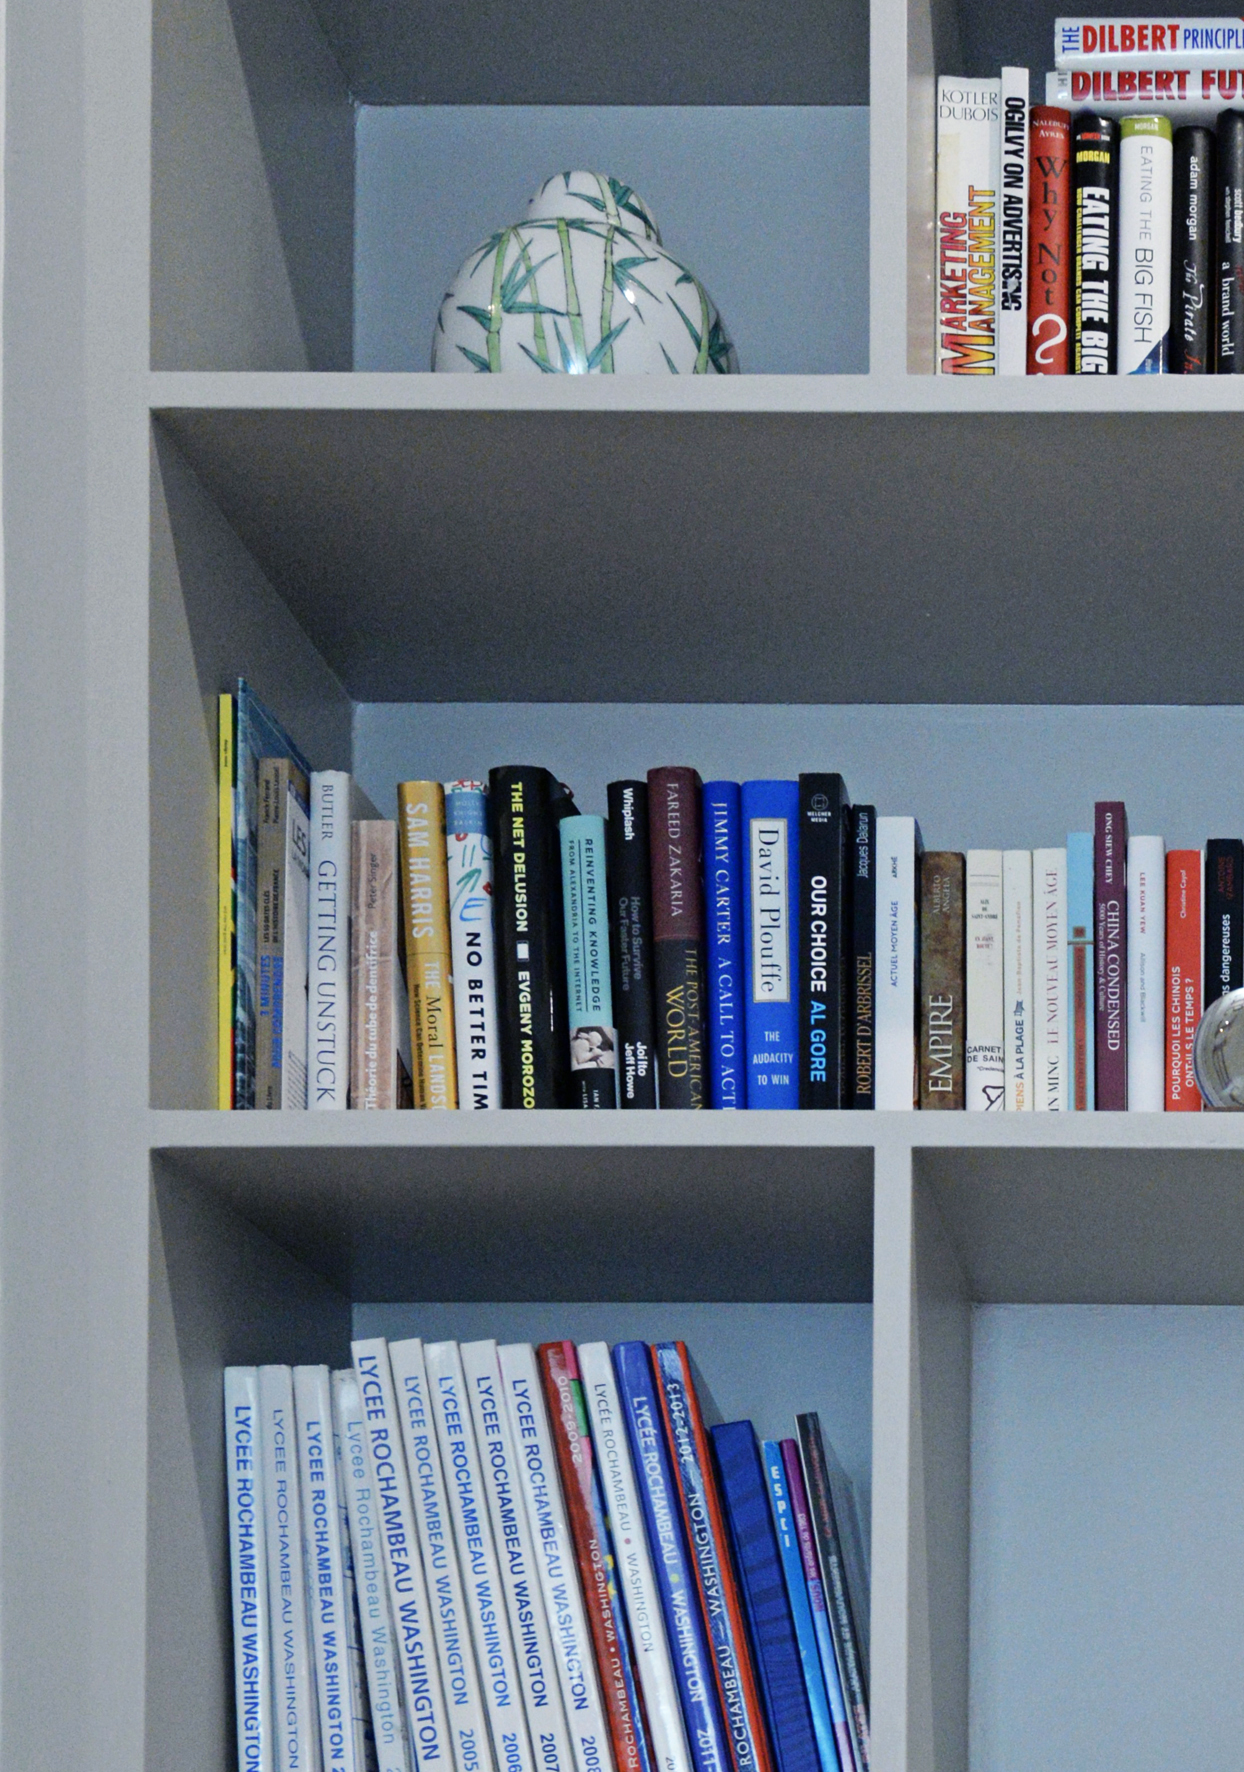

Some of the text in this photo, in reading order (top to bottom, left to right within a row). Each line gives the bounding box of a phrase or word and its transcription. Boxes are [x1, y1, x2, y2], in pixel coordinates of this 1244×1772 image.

[941, 89, 998, 106] KOTLER
[1062, 26, 1079, 53] THE
[1082, 25, 1180, 53] DILBERT
[939, 105, 999, 122] DUBOIS
[1004, 163, 1023, 188] ON
[1006, 98, 1025, 159] OGILVY
[1076, 151, 1110, 164] MORGAN
[1134, 146, 1153, 343] EATING THE BIG FISH
[1187, 156, 1200, 241] adam morgan
[1080, 187, 1110, 374] EATING THE BIG
[406, 803, 433, 938] SAM HARRIS
[621, 788, 635, 840] Whiplash
[667, 783, 683, 916] FAREED ZAKARIA
[1105, 813, 1113, 885] ONG SIEW CHEY
[316, 784, 337, 1102] BUTLER GETTING UNSTUCK
[511, 782, 533, 1034] THE NET DELUSION EVGENY
[568, 840, 583, 1012] FROM ALEXANDRIA TO THE INTERNET
[585, 839, 601, 1012] REINVENTING KNOWLEDGE
[711, 802, 735, 1058] JIMMY CARTER A CALL TO
[758, 828, 782, 993] David Plouffe
[466, 932, 485, 1060] NO BETTER
[665, 985, 688, 1077] WORLD
[764, 1031, 780, 1041] THE
[810, 875, 827, 1082] OUR CHOICE AL GORE
[1106, 900, 1120, 1051] CHINA CONDENSED
[1171, 966, 1181, 1100] POURQUOI LES CHINOIS
[752, 1053, 794, 1064] AUDACITY
[757, 1075, 790, 1085] TO WIN
[928, 995, 953, 1092] EMPIRE
[235, 1406, 252, 1471] LYCEE
[306, 1421, 324, 1482] LYCEE
[358, 1356, 385, 1421] LYCEE
[404, 1376, 426, 1429] LYCEE
[237, 1479, 257, 1628] ROCHAMBEAU
[312, 1490, 333, 1623] ROCHAMBEAU
[370, 1429, 413, 1593] ROCHAMBEAU
[413, 1435, 447, 1569] ROCHAMBEAU
[476, 1376, 499, 1436] LYCEE
[489, 1441, 525, 1575] ROCHAMBEAU
[514, 1580, 548, 1707] WASHINGTON
[512, 1379, 536, 1439] LYCEE
[526, 1444, 563, 1578] ROCHAMBEAU
[552, 1583, 588, 1710] WASHINGTON
[323, 1632, 344, 1760] WASHINGTON
[399, 1600, 440, 1761] WASHINGTON
[436, 1576, 469, 1705] WASHINGTON
